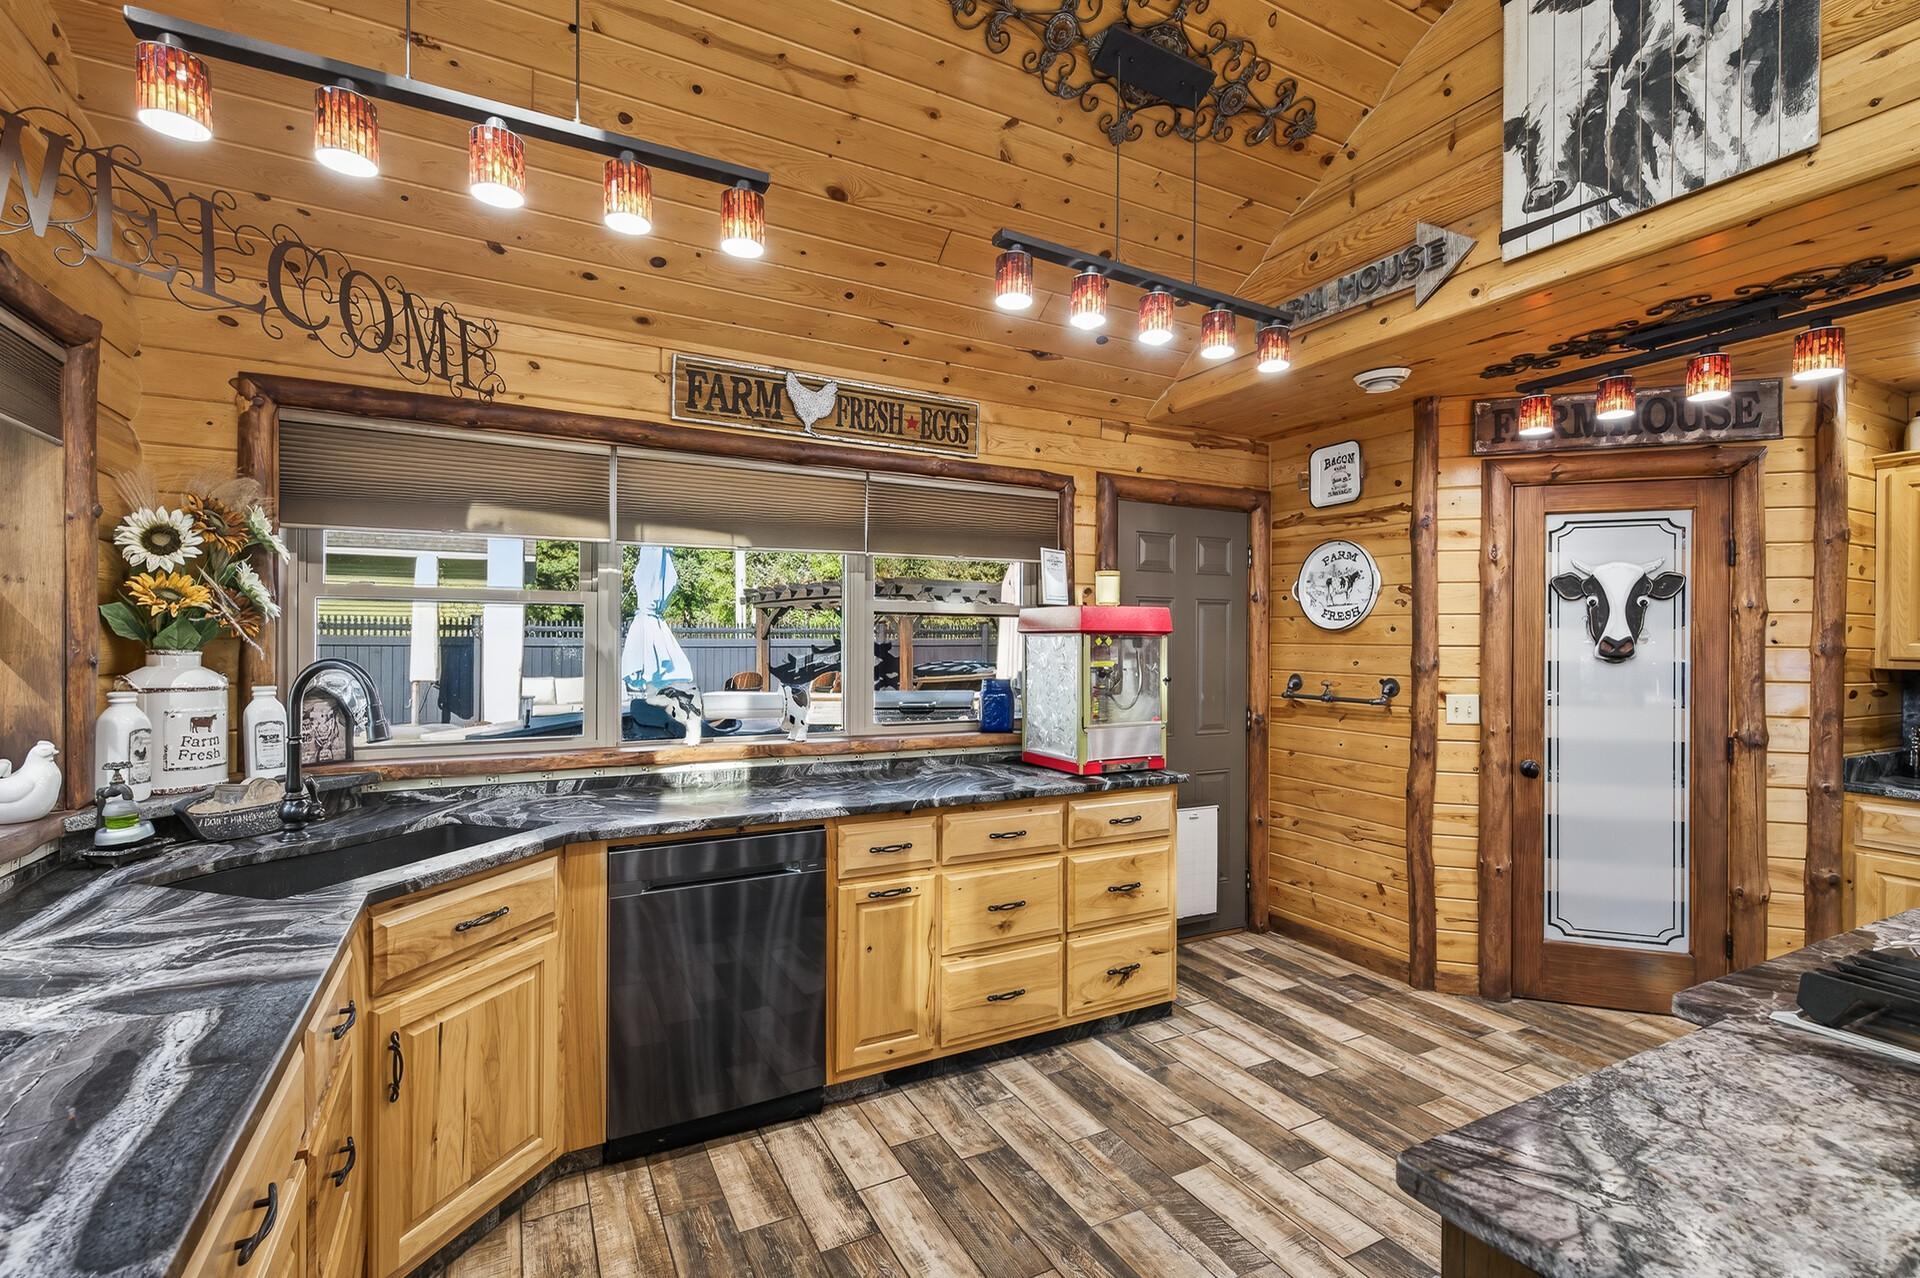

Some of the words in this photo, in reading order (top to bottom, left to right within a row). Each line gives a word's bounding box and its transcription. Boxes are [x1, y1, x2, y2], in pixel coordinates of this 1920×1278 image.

[1337, 237, 1447, 306] HOUSE
[685, 370, 785, 420] FARM
[835, 394, 905, 436] FRESH
[919, 406, 969, 445] EGGS
[1324, 452, 1355, 471] BACON
[1321, 550, 1358, 567] FARM
[1321, 606, 1360, 621] FRESH
[180, 735, 220, 747] Farm
[178, 747, 221, 761] Fresh
